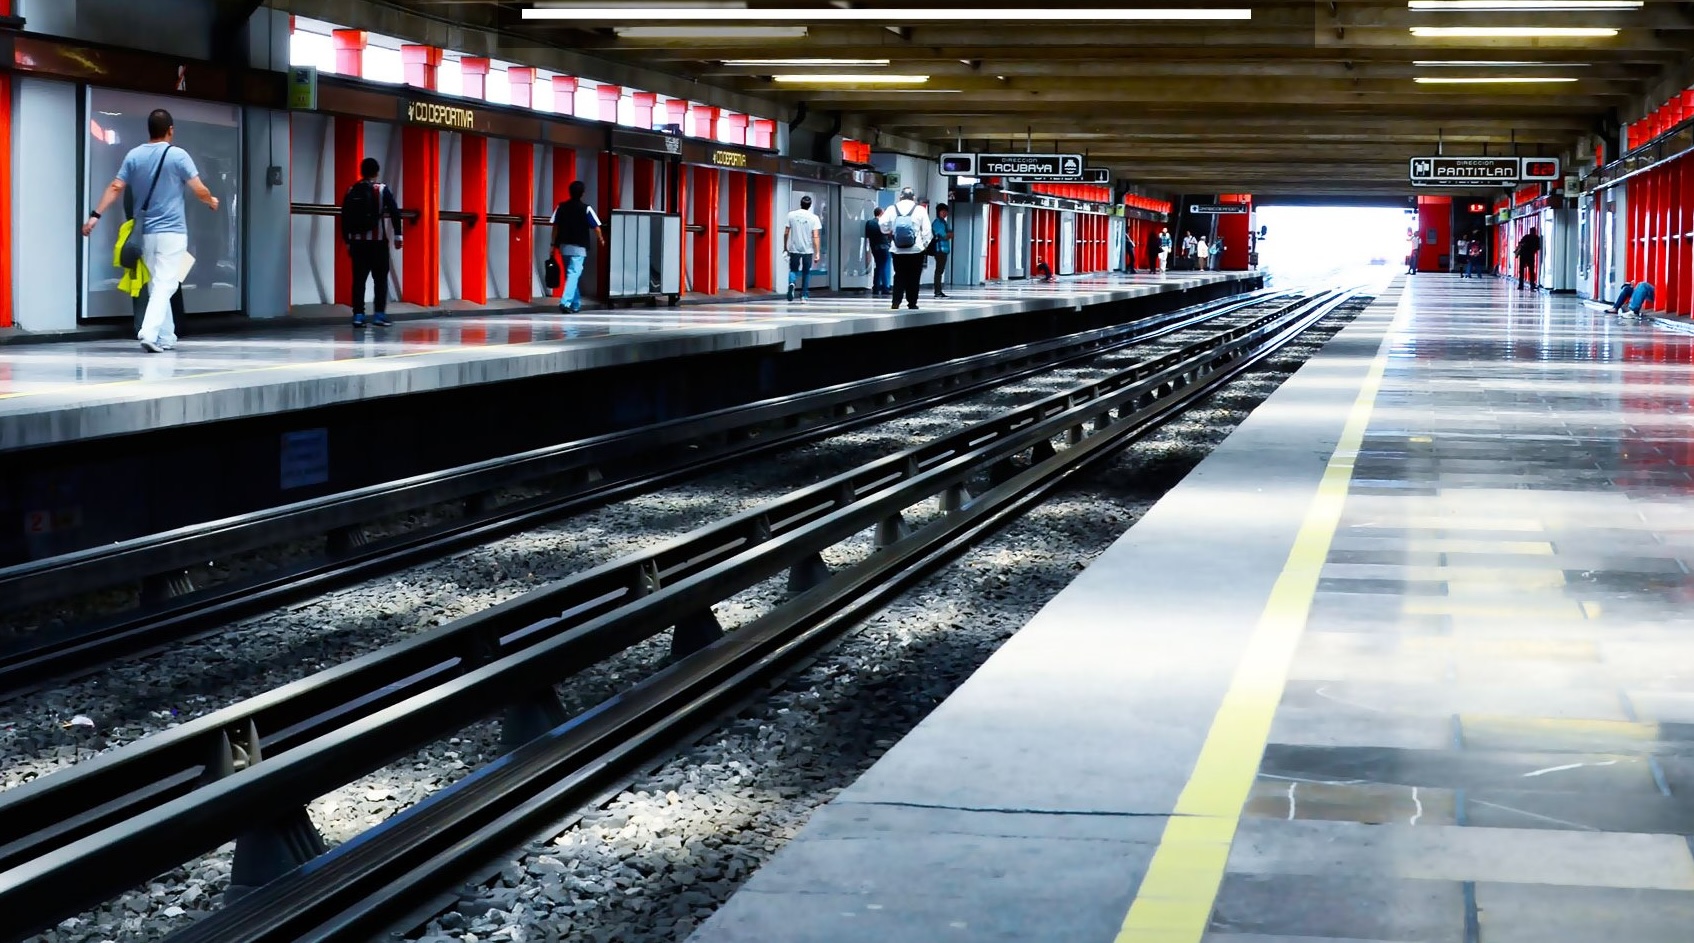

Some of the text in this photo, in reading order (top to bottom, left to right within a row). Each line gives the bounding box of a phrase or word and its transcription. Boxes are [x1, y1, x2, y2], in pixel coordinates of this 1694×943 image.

[415, 102, 474, 129] CD DEPORTIVA
[987, 163, 1053, 173] TACUBAYA
[1437, 167, 1513, 176] PANTITLAN
